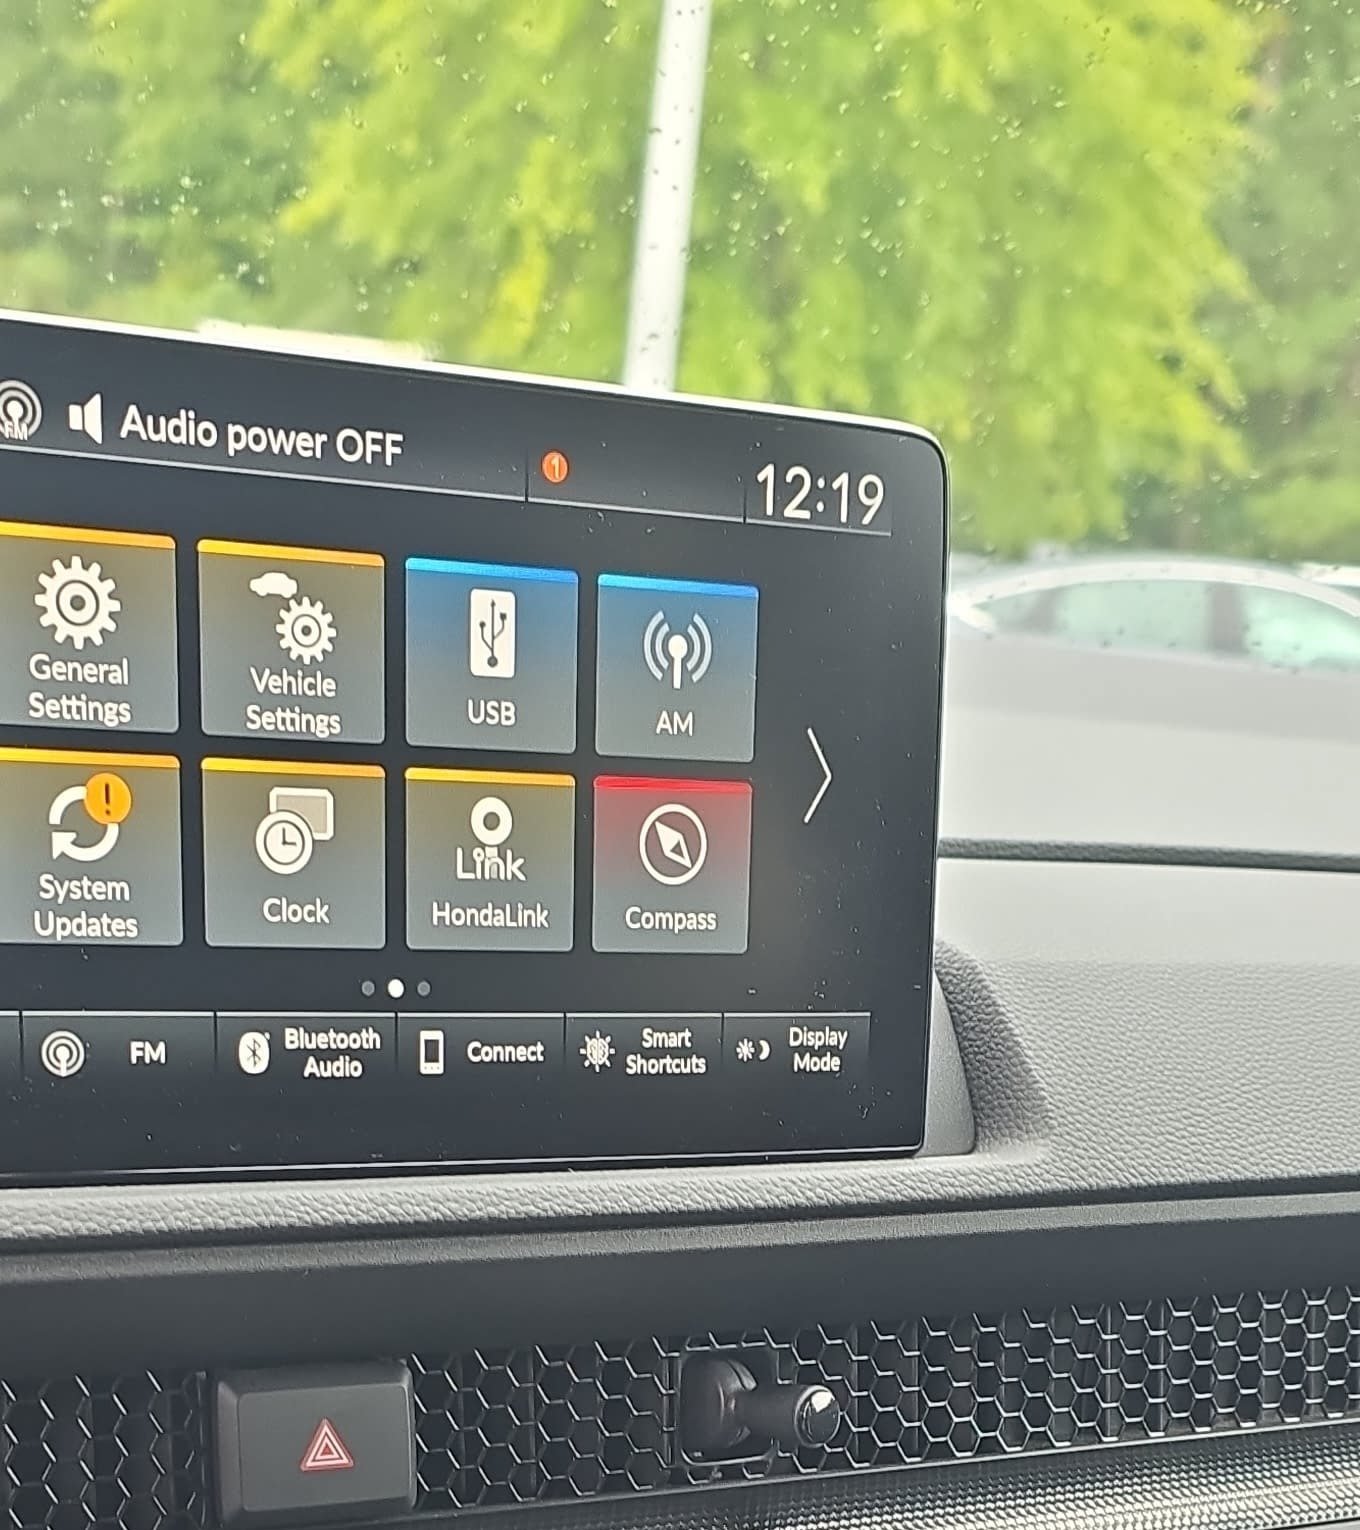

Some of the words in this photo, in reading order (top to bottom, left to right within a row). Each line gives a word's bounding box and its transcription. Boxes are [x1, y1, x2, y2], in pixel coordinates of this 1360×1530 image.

[120, 404, 218, 448] Audio
[227, 423, 328, 460] power
[336, 429, 405, 467] OFF
[756, 462, 885, 526] 12:19
[29, 653, 129, 687] General
[251, 667, 337, 698] Vehicle
[28, 692, 132, 729] Settings
[246, 704, 342, 737] Settings
[467, 699, 517, 727] USB
[655, 710, 694, 738] AM
[39, 874, 130, 905] System
[263, 897, 330, 924] Clock
[432, 901, 549, 930] HondaLink
[625, 905, 718, 934] Compass
[34, 911, 138, 941] Updates
[129, 1041, 167, 1065] FM
[284, 1027, 381, 1051] Bluetooth
[467, 1040, 545, 1064] Connect
[641, 1028, 692, 1050] Smart
[789, 1026, 849, 1052] Display
[303, 1055, 363, 1079] Audio
[626, 1053, 707, 1076] Shortcuts
[793, 1052, 841, 1074] Mode
